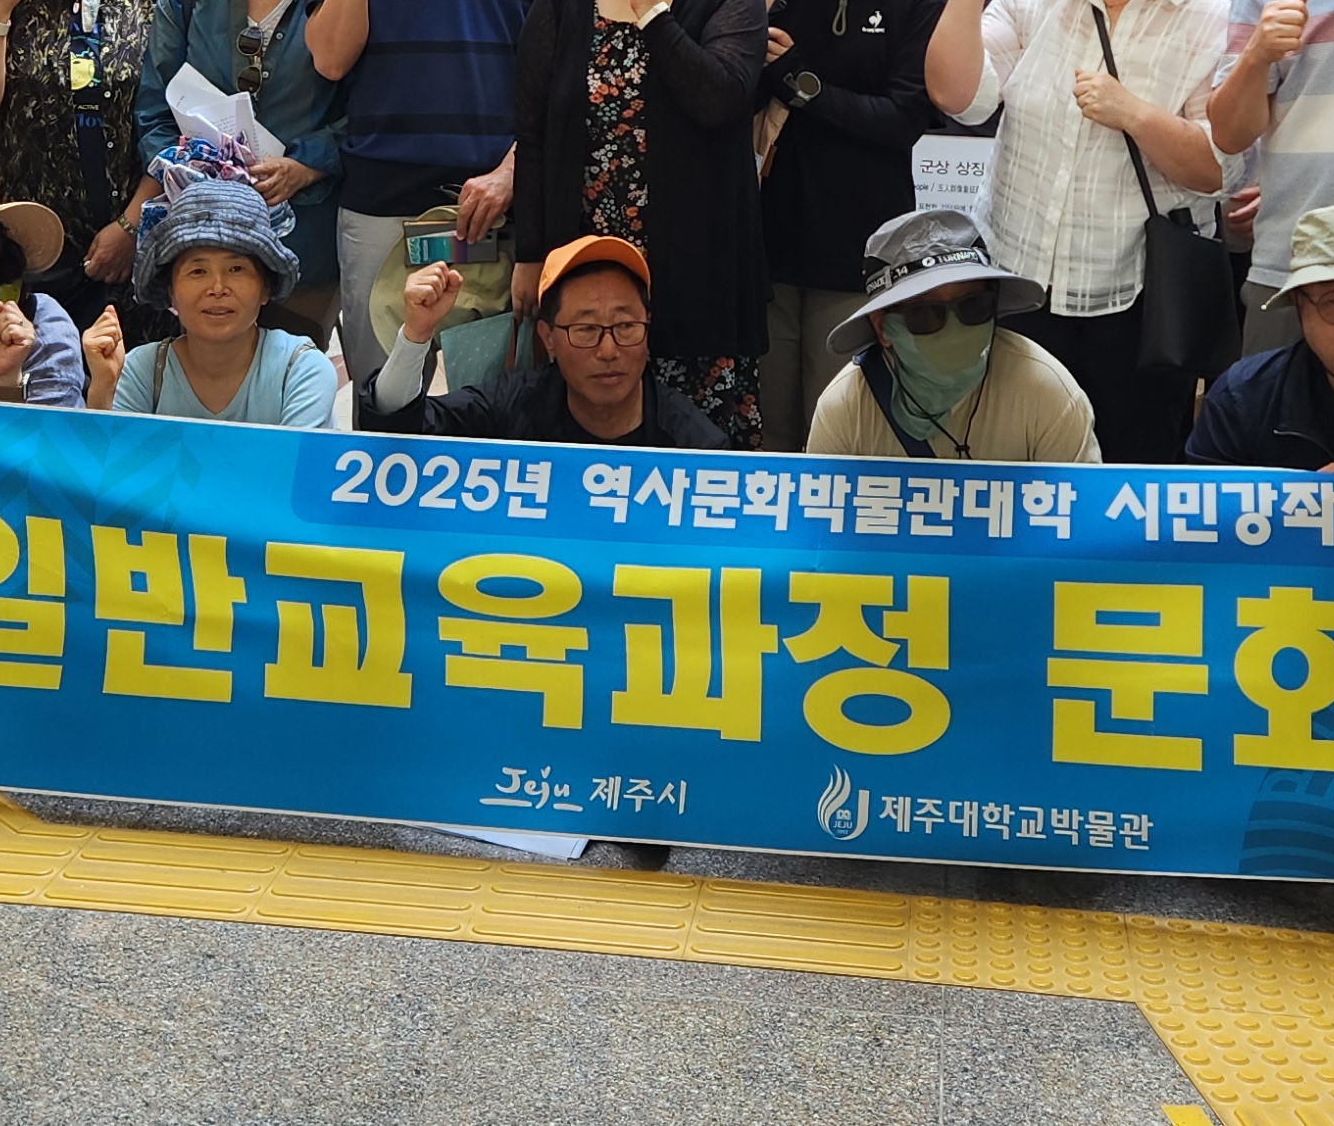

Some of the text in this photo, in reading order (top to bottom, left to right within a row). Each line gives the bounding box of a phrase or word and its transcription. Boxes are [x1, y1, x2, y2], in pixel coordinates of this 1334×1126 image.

[919, 159, 985, 177] 군상 상징
[330, 450, 553, 519] 2025년
[582, 462, 1077, 539] 역사문화박물관대학
[493, 765, 687, 815] Jeju 제주시
[832, 820, 853, 829] JEJU
[878, 795, 1154, 851] 제주대학교박물관
